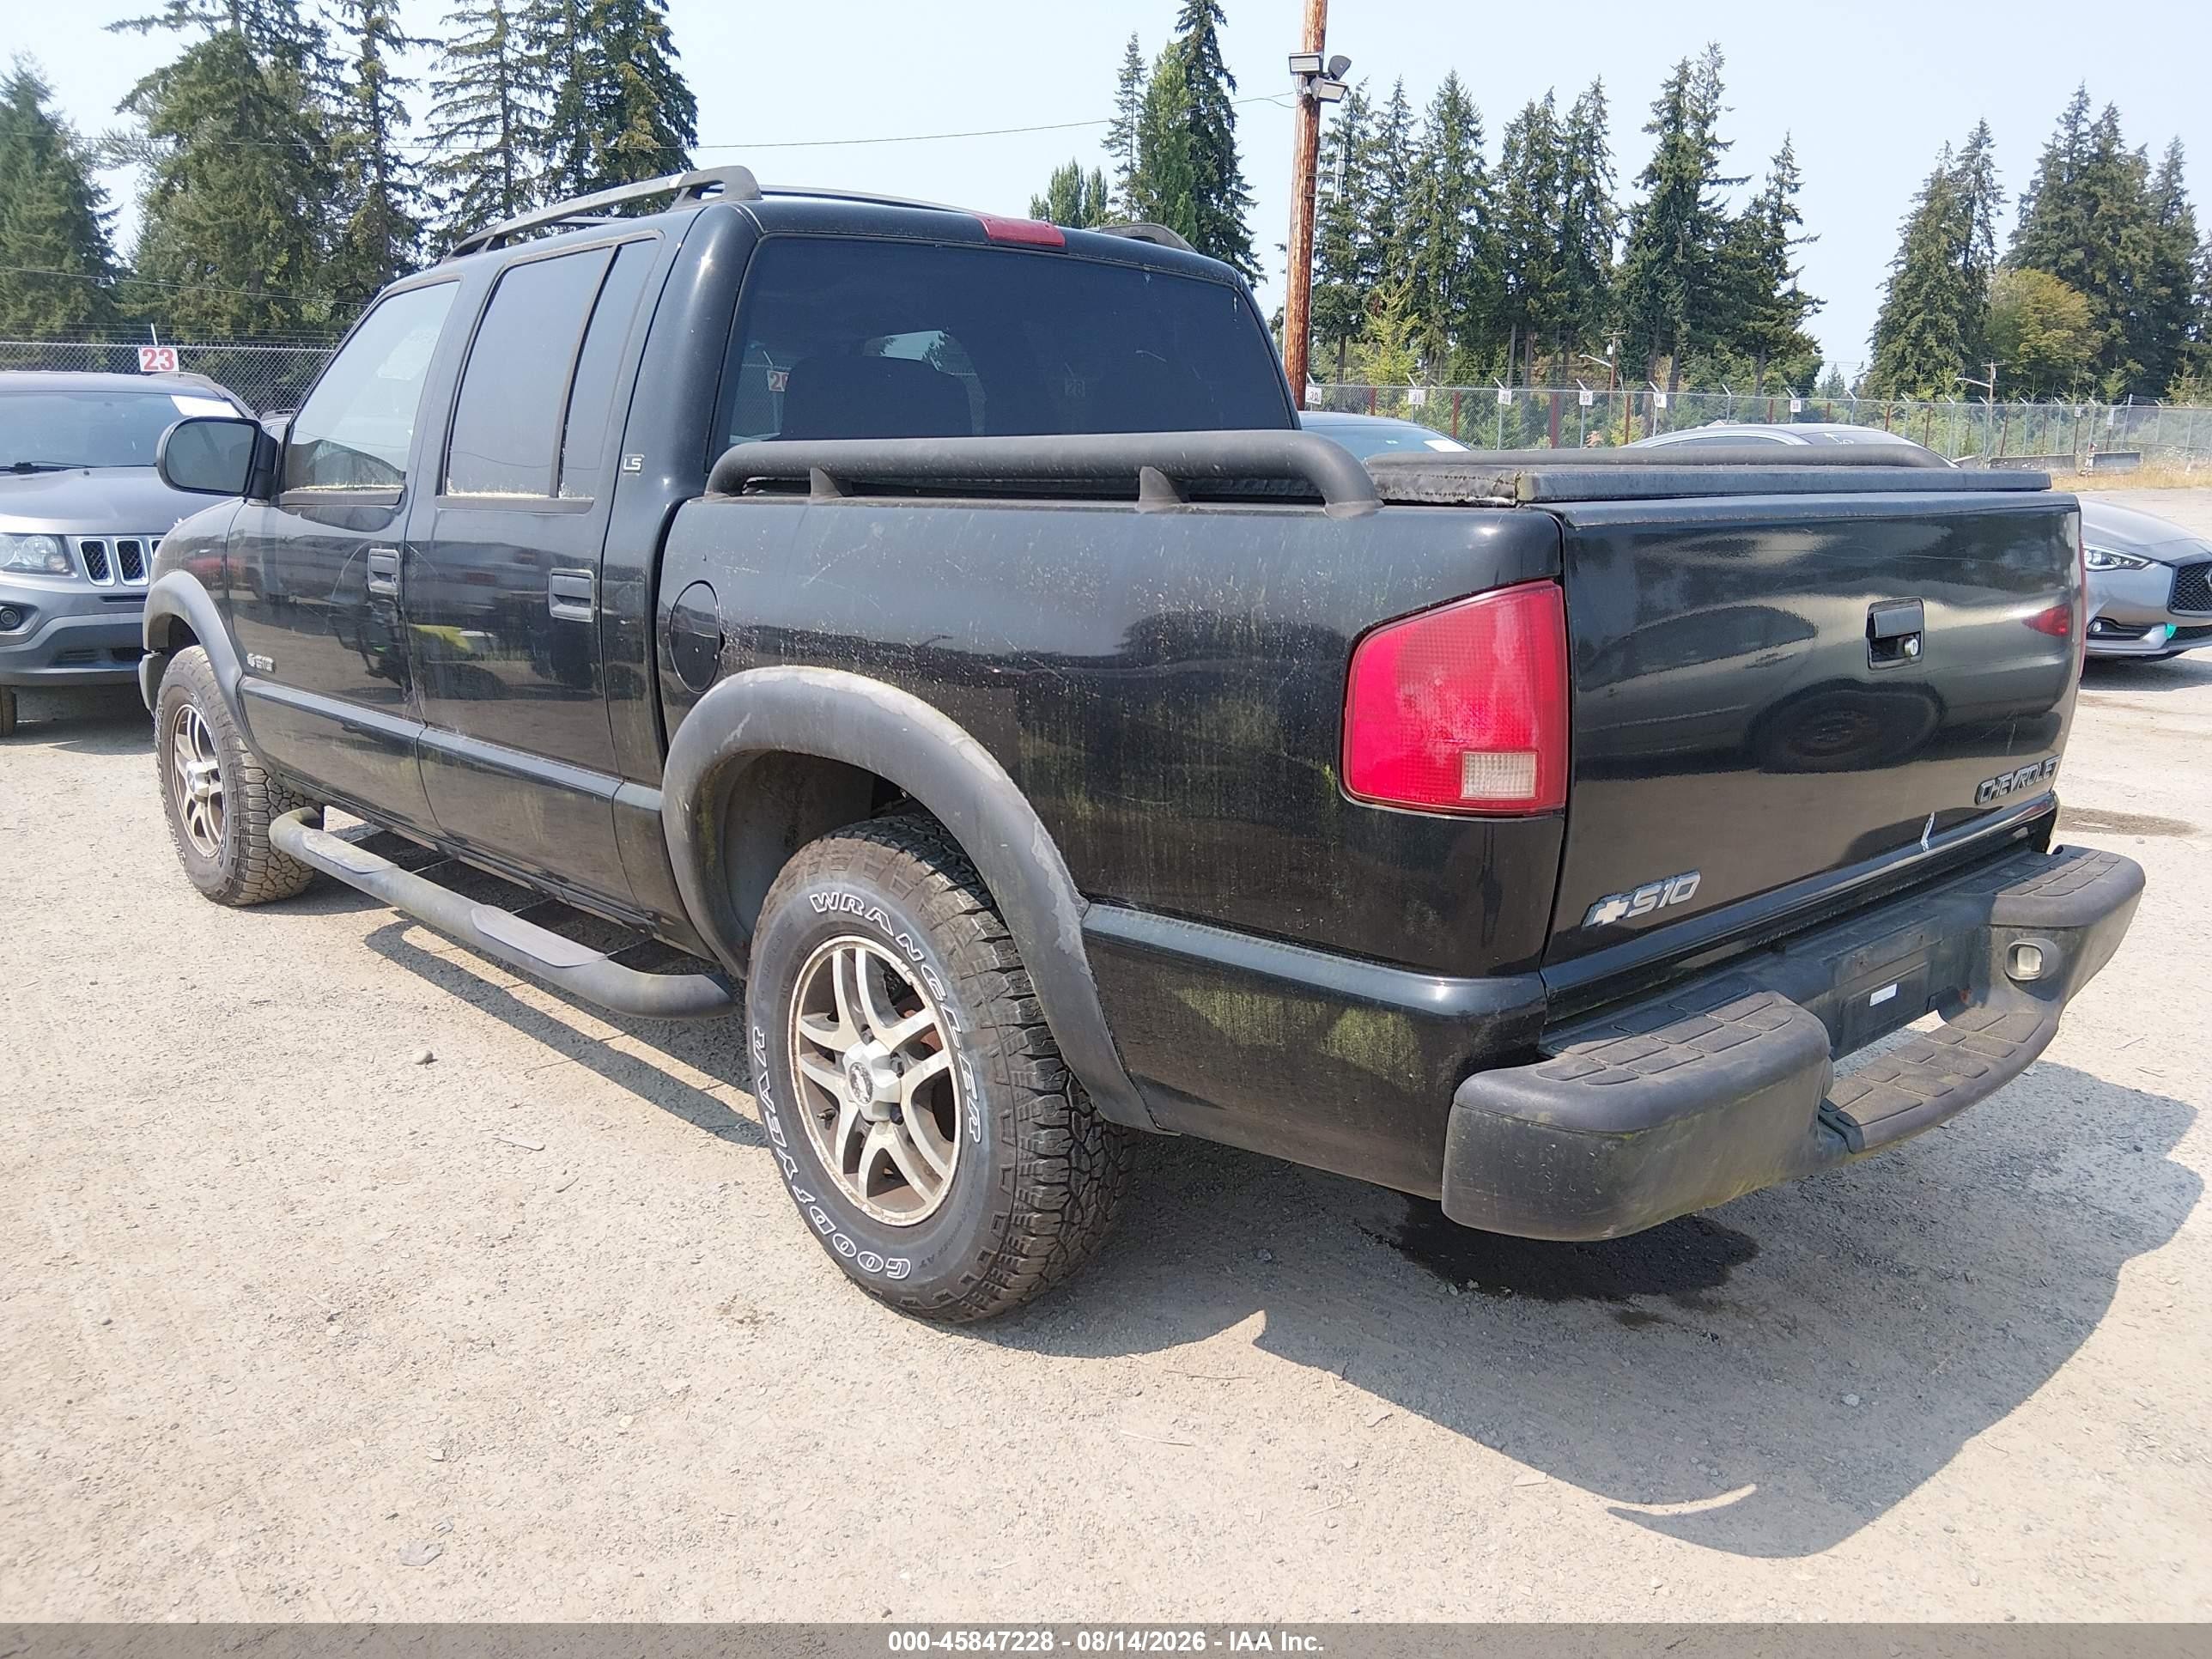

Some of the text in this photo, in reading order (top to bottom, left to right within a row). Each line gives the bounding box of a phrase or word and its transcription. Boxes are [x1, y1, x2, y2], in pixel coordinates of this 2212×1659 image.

[143, 349, 174, 371] 23
[623, 458, 642, 471] LS
[1978, 755, 2061, 803] CHEVROLET
[1627, 872, 1700, 918] S10
[810, 891, 981, 1144] WRANGLER
[753, 1026, 911, 1279] GOODYEAR
